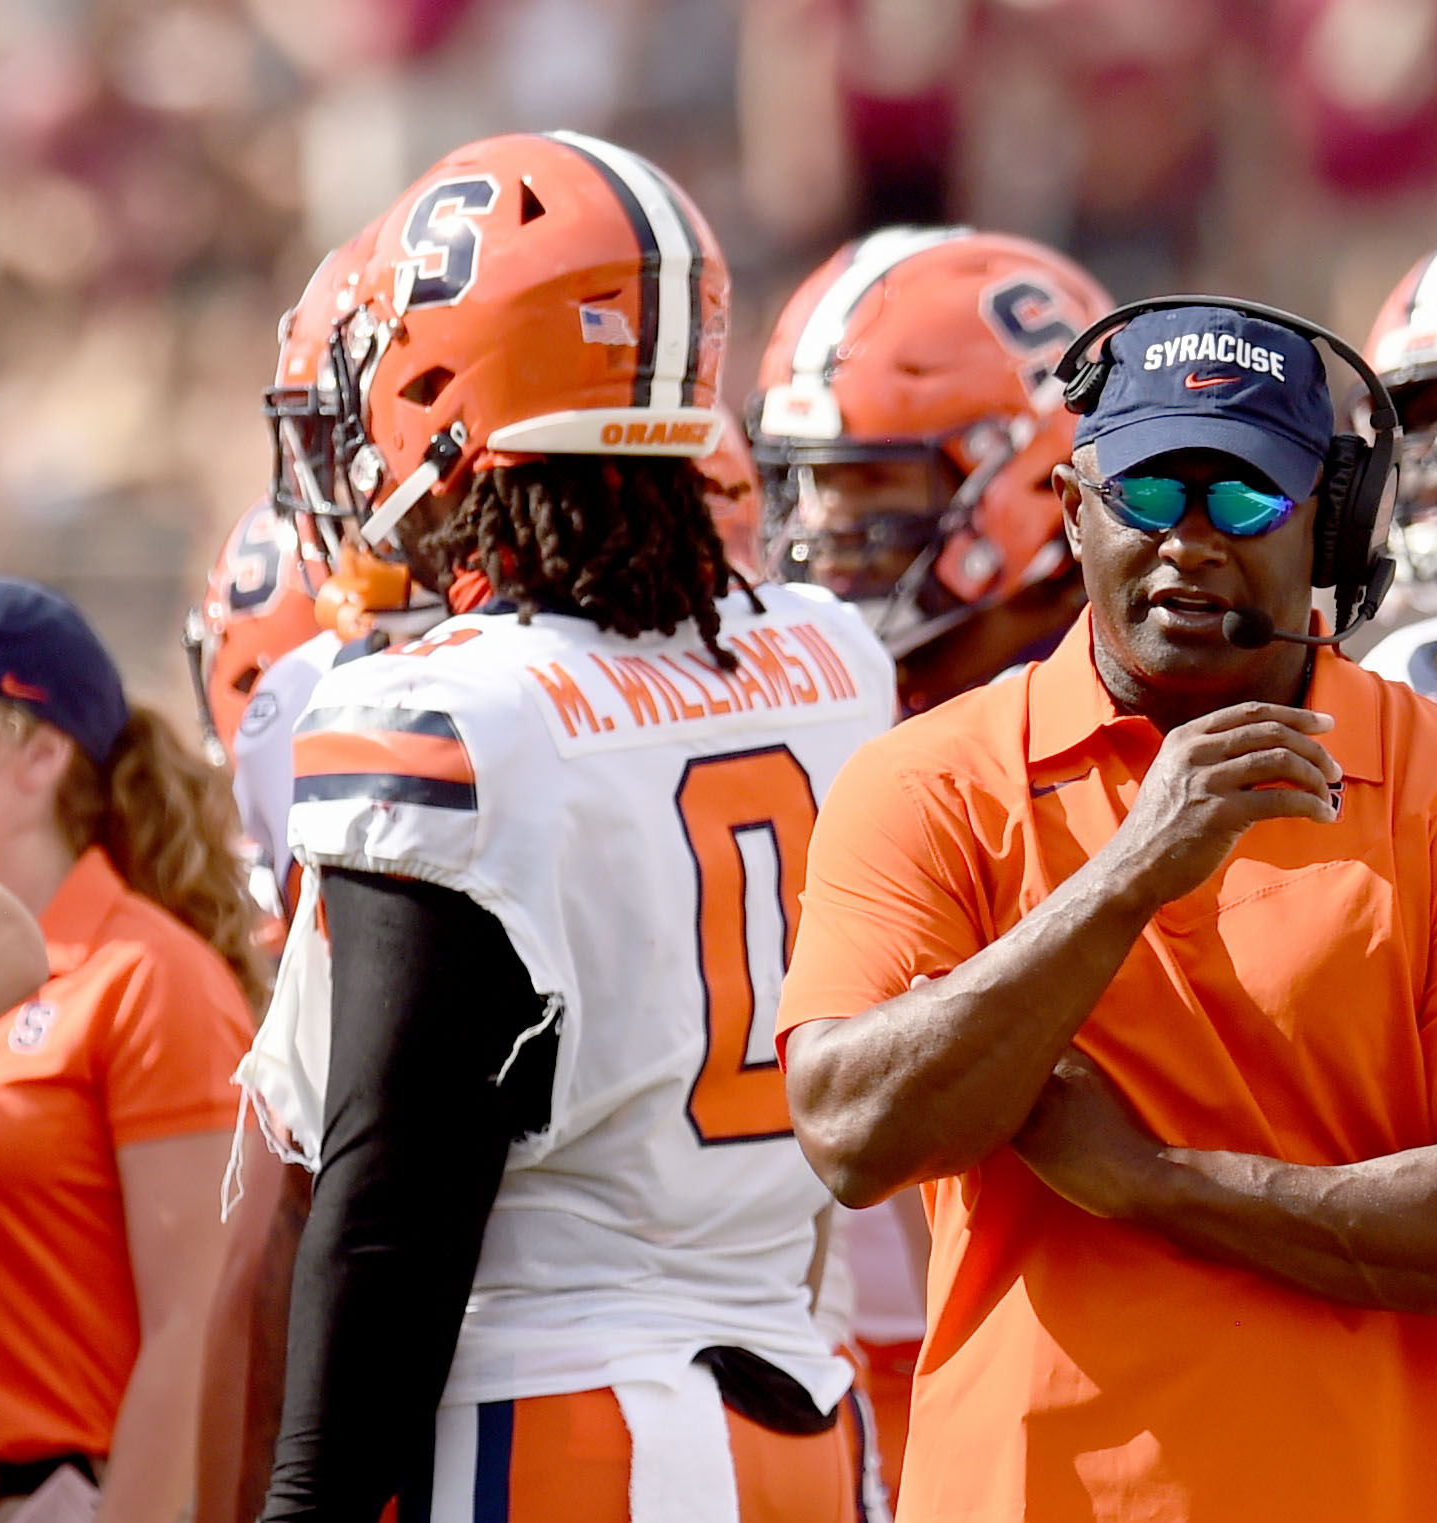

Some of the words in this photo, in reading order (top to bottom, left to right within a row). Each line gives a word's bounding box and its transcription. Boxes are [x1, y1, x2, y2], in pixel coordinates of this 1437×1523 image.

[394, 173, 501, 312] S
[1142, 332, 1286, 383] SYRACUSE
[600, 421, 714, 446] ORANGE
[525, 661, 616, 738] M.
[787, 623, 857, 700] III
[673, 743, 820, 1149] 0
